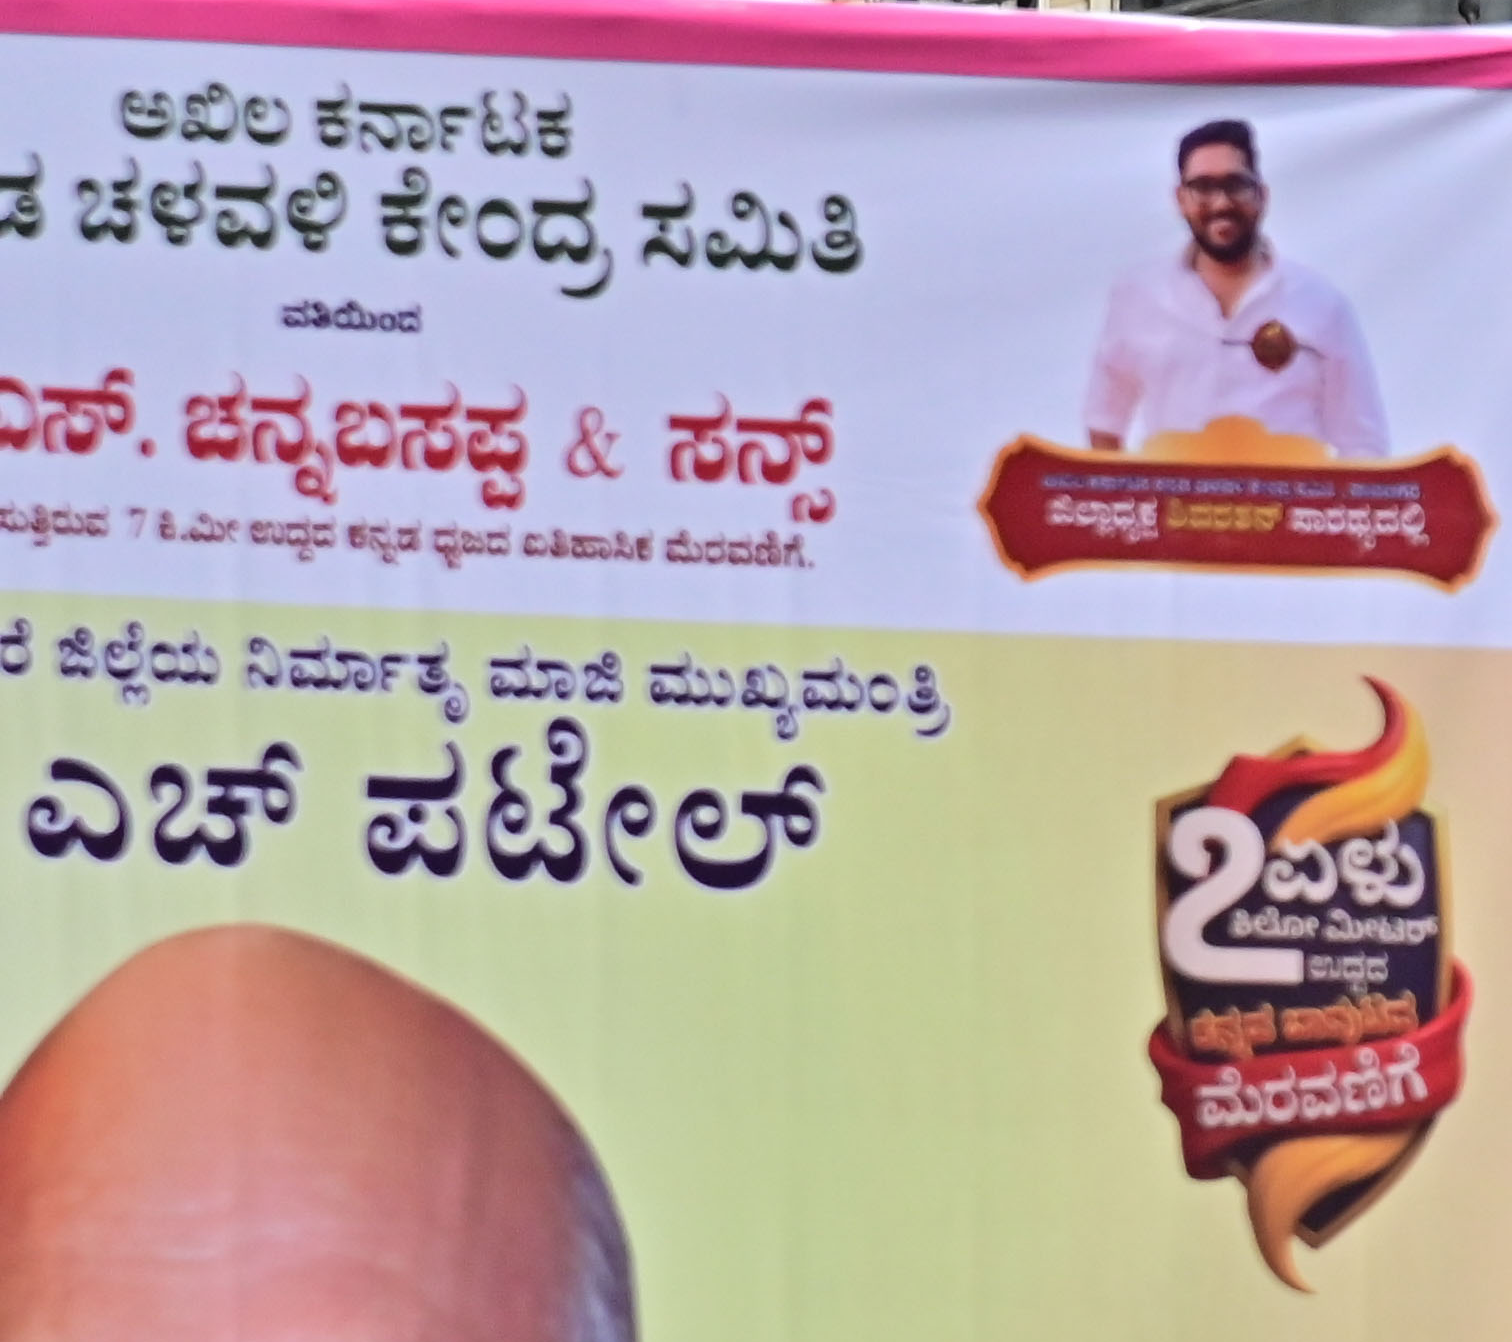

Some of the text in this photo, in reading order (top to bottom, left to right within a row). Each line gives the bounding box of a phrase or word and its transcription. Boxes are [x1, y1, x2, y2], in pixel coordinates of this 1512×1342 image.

[123, 80, 575, 159] ಅಖಿಲ ಕರ್ನಾಟಕ
[76, 158, 348, 252] ಚಳವಳಿ
[380, 167, 615, 298] ಕೇಂದ್ರ
[641, 183, 863, 272] ಸಮಿತಿ
[184, 373, 530, 509] ಚನ್ನಬಸಪ್ಪ
[566, 405, 624, 480] &
[668, 391, 837, 525] ಸನ್ಸ್
[130, 509, 147, 540] 7
[348, 524, 423, 565] ಕನ್ನಡ
[59, 620, 220, 706] ಜಿಲ್ಲೆಯ
[489, 644, 625, 705] ಮಾಜಿ
[649, 655, 953, 740] ಮುಖ್ಯಮಂತ್ರಿ
[26, 716, 826, 890] ಎಚ್ ಪಟೇಲ್
[1195, 1039, 1429, 1130] ಮೆರವಣಿಗೆ
